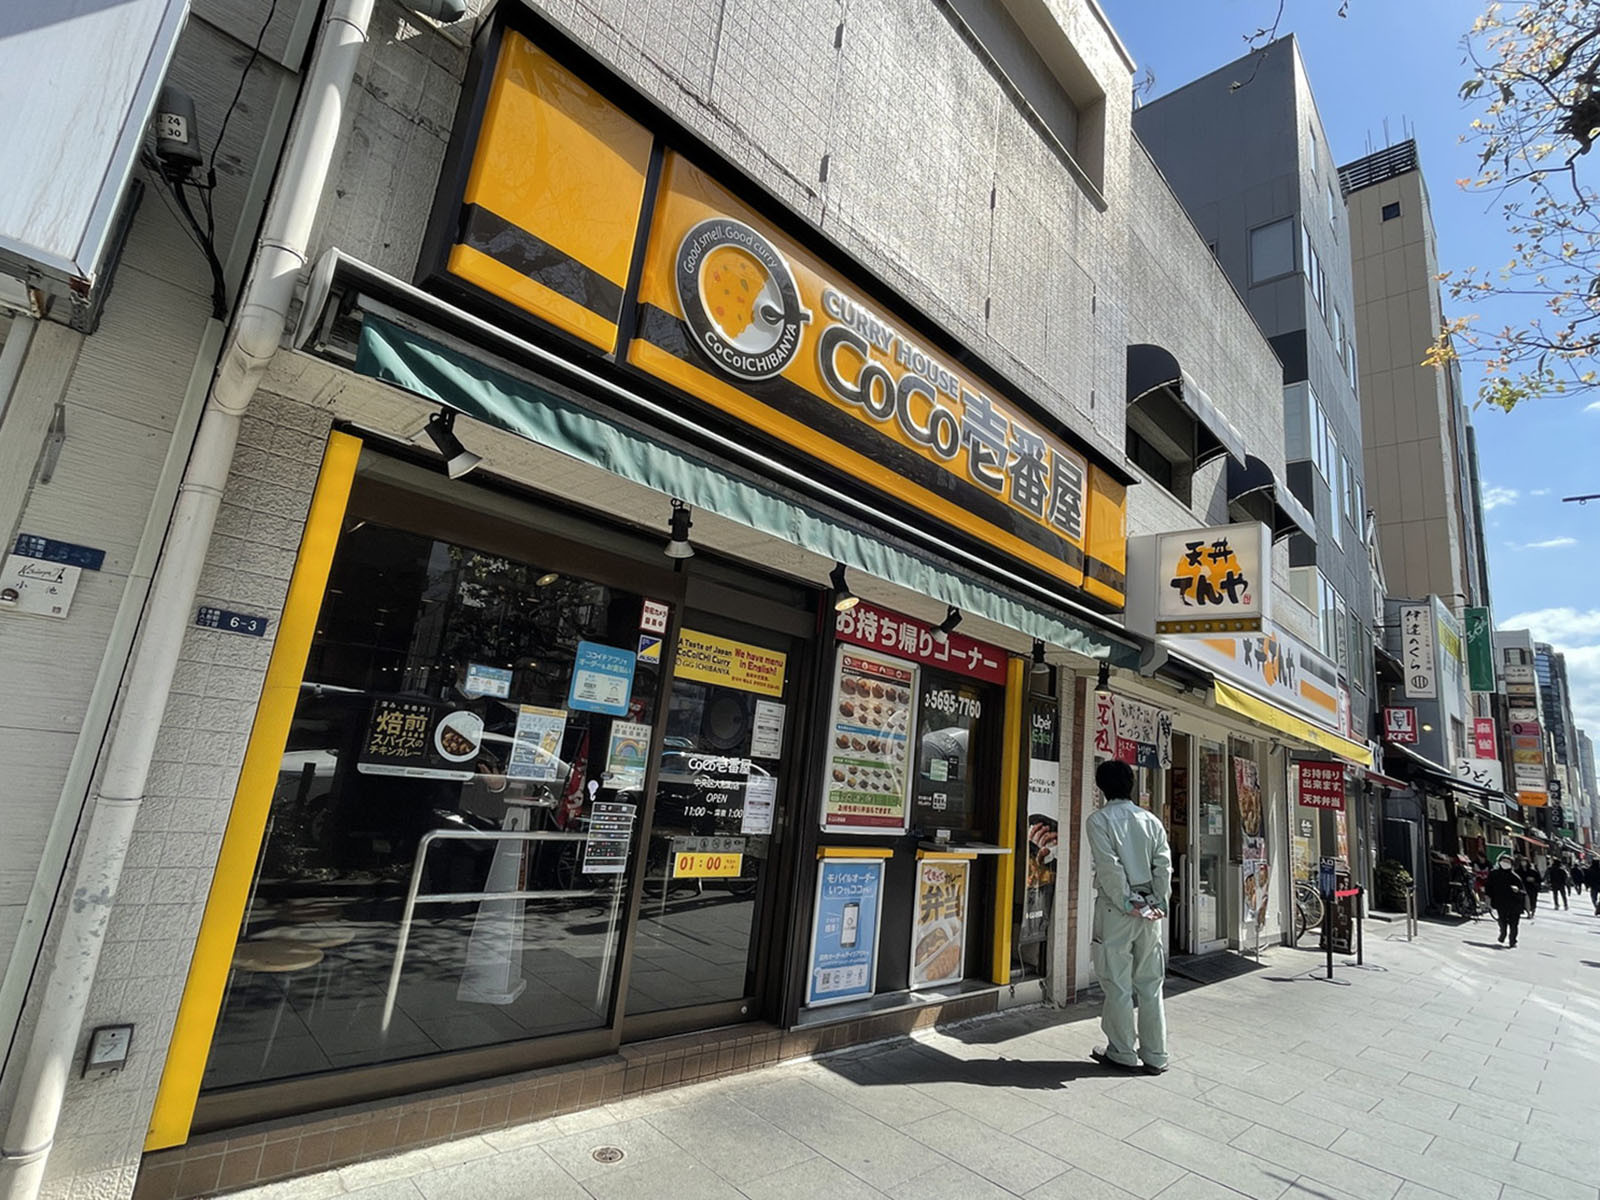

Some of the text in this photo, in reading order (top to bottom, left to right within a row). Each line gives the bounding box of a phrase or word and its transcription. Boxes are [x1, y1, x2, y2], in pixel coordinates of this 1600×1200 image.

[754, 241, 778, 268] curry
[824, 289, 960, 399] CURRY HOUSE
[1186, 537, 1234, 567] 天丼
[1170, 571, 1249, 606] てんや
[230, 616, 257, 631] 6-3
[685, 639, 704, 650] Taste
[713, 646, 733, 657] Japan
[835, 608, 998, 670] お持ち帰りコーナー
[711, 655, 731, 667] Curry
[735, 648, 784, 668] We have menu
[376, 710, 429, 739] 焙煎
[1032, 714, 1051, 730] Uber
[371, 733, 424, 748] スパイスの
[1388, 732, 1414, 742] KFC
[369, 744, 422, 757] チキンカレー
[1302, 768, 1340, 780] お持帰り
[705, 793, 728, 803] OPEN
[921, 883, 961, 924] 弁当
